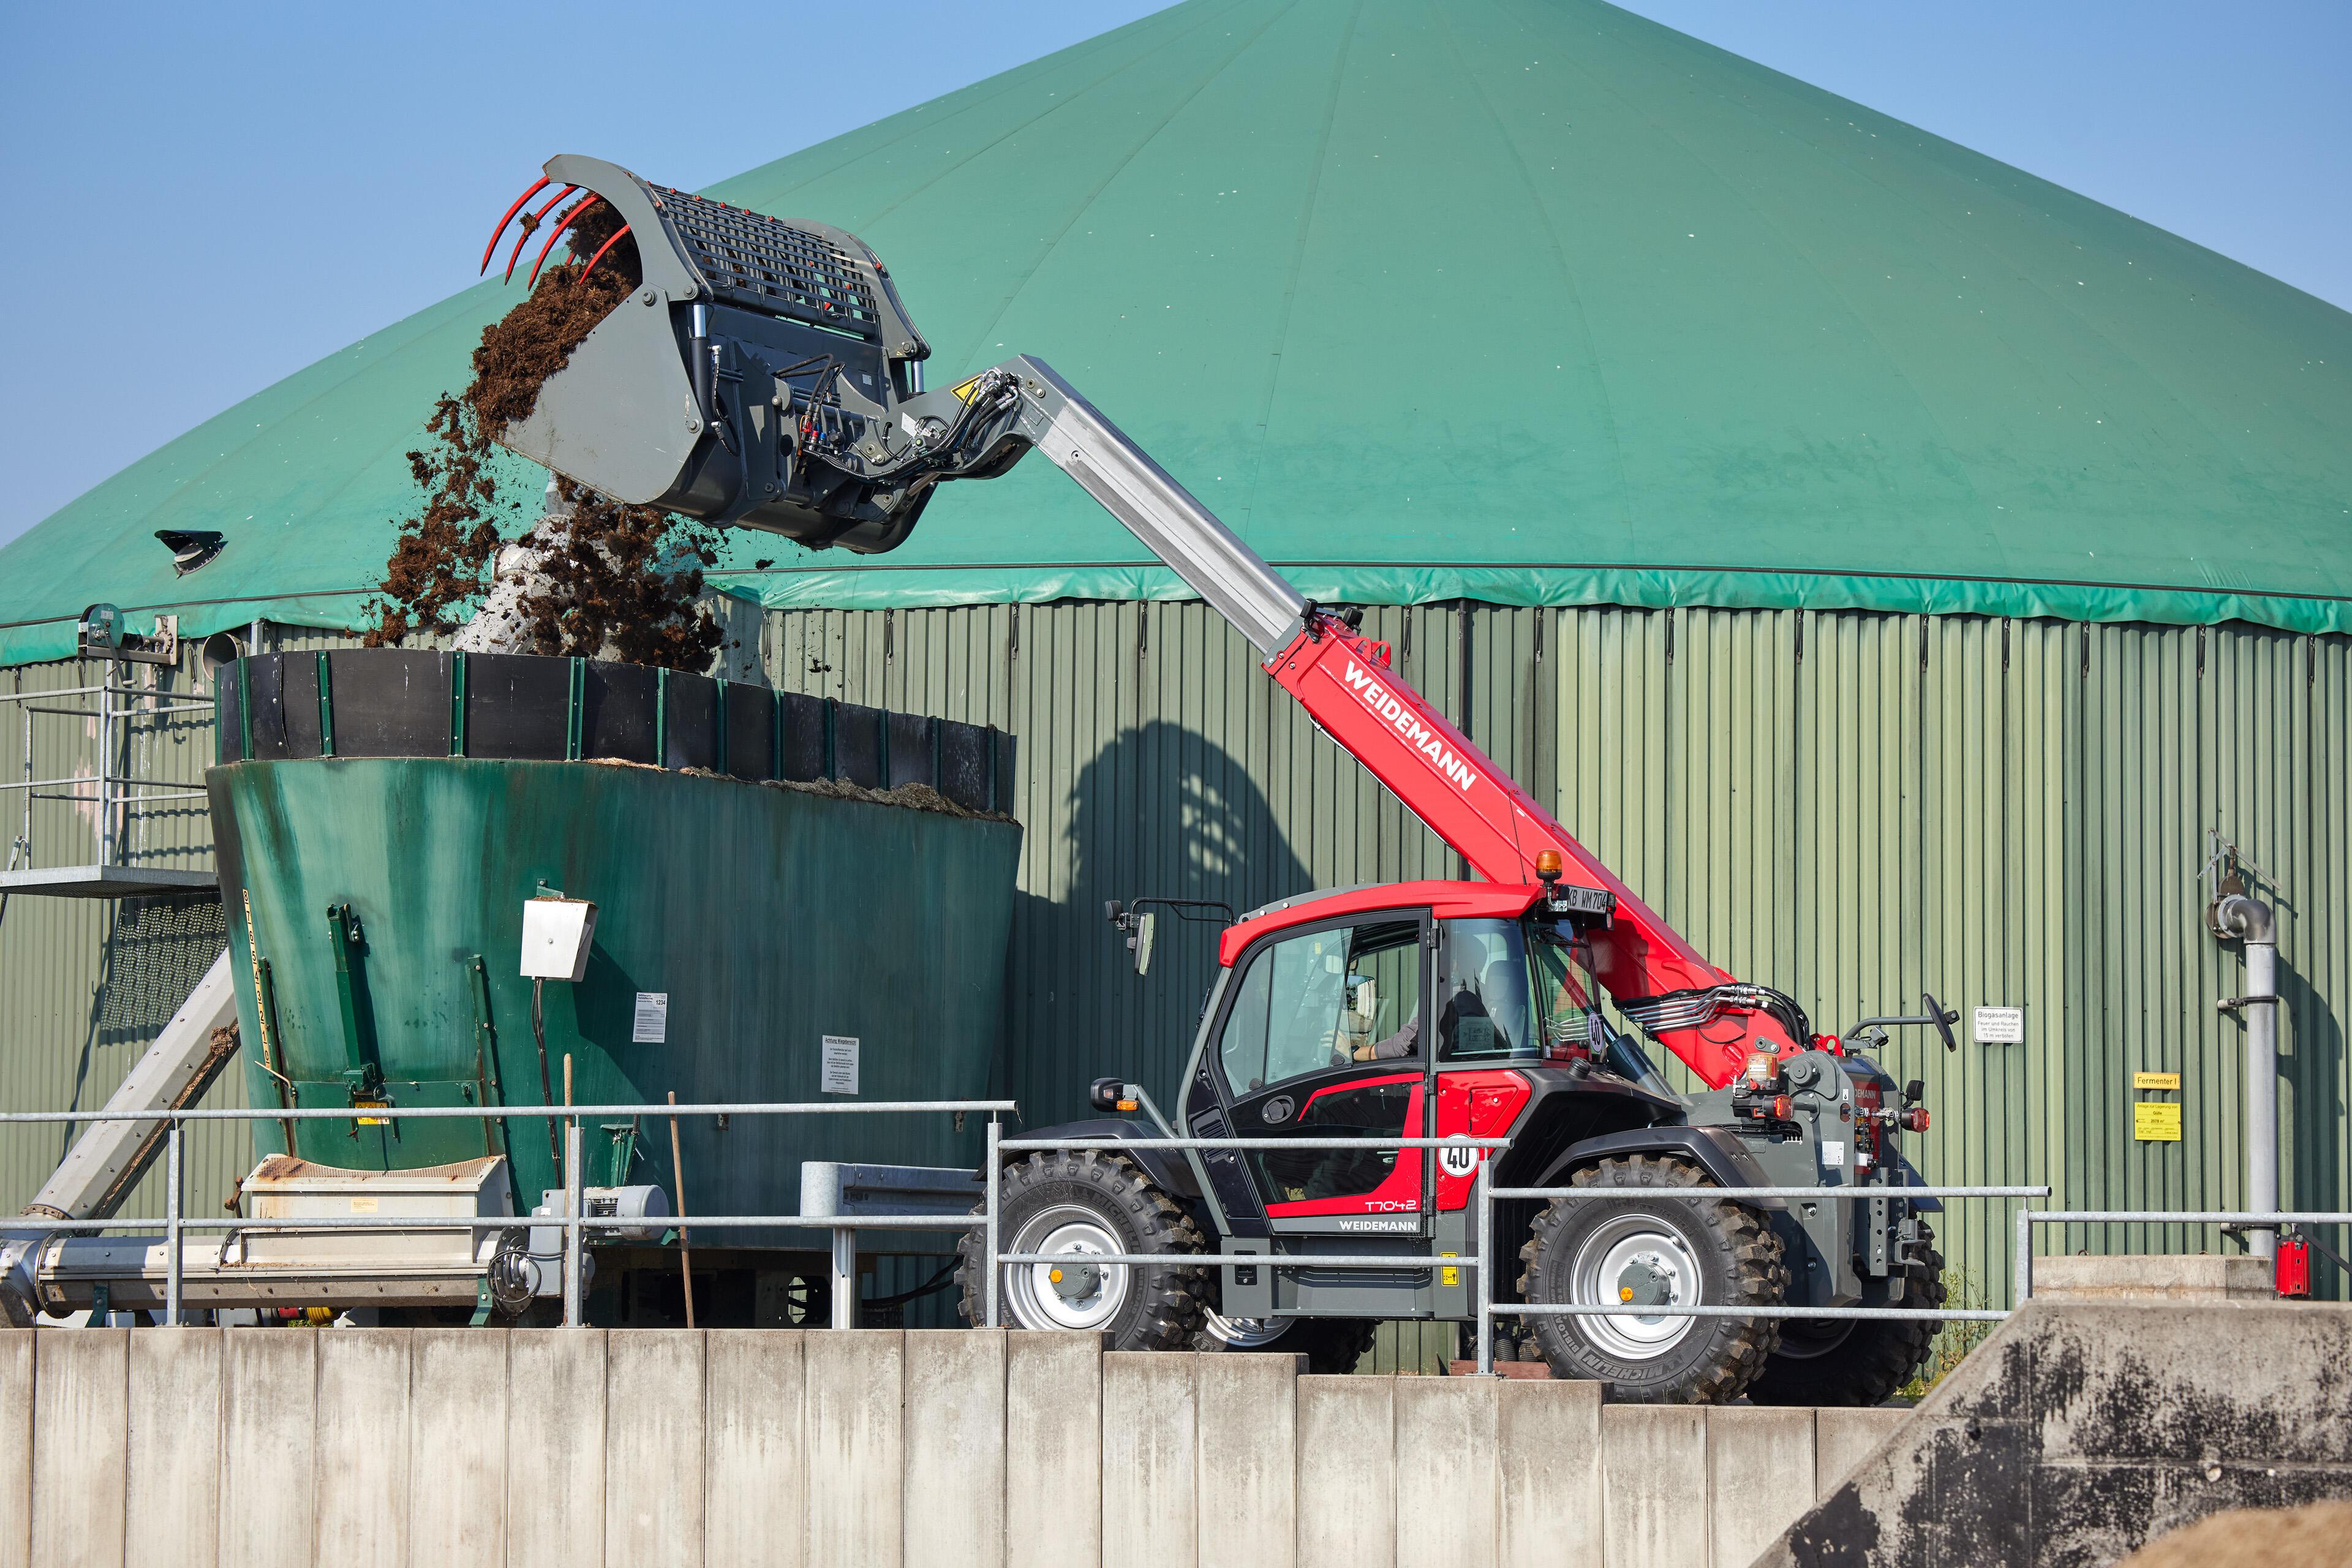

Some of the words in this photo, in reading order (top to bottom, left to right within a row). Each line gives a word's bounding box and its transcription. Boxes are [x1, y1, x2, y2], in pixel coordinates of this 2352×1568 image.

[1344, 660, 1477, 791] WEIDEMANN
[244, 891, 248, 902] 8
[246, 911, 250, 922] 7
[249, 931, 254, 941] 6
[252, 951, 256, 961] 5
[255, 971, 259, 981] 4
[257, 990, 262, 1001] 3
[260, 1011, 264, 1021] 2
[1978, 1011, 2019, 1020] Biogasanlage
[262, 1030, 266, 1041] 1
[1591, 1019, 1600, 1046] 40
[265, 1050, 269, 1061] 0
[1447, 1147, 1469, 1169] 40
[1365, 1200, 1417, 1212] T7042
[1339, 1221, 1417, 1231] WEIDEMANN
[1554, 1314, 1580, 1354] BIBLOA
[1582, 1354, 1664, 1380] MICHELIN
